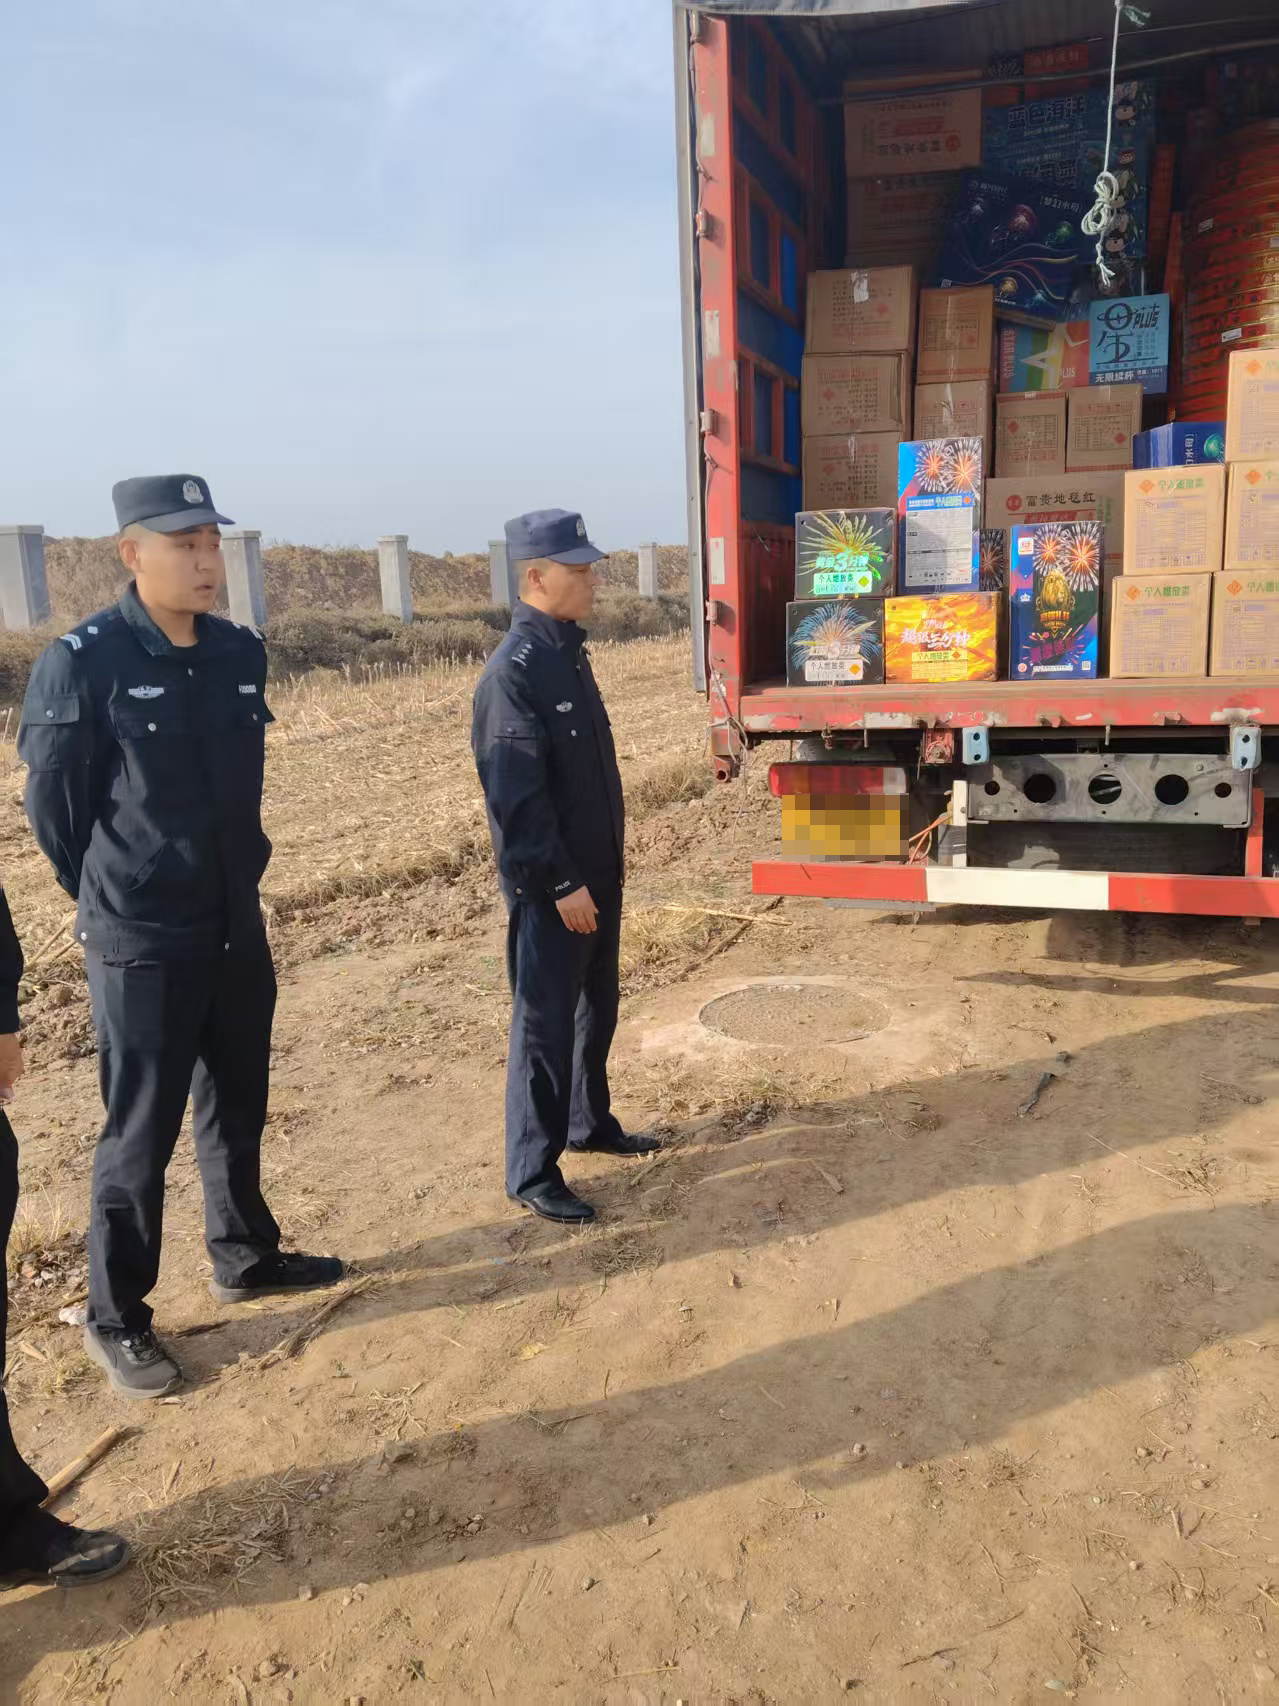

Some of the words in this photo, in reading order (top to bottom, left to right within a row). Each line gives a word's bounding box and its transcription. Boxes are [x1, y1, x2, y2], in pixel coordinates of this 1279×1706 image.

[1026, 491, 1097, 507] 富贵地毯红
[554, 880, 571, 892] POLICE
